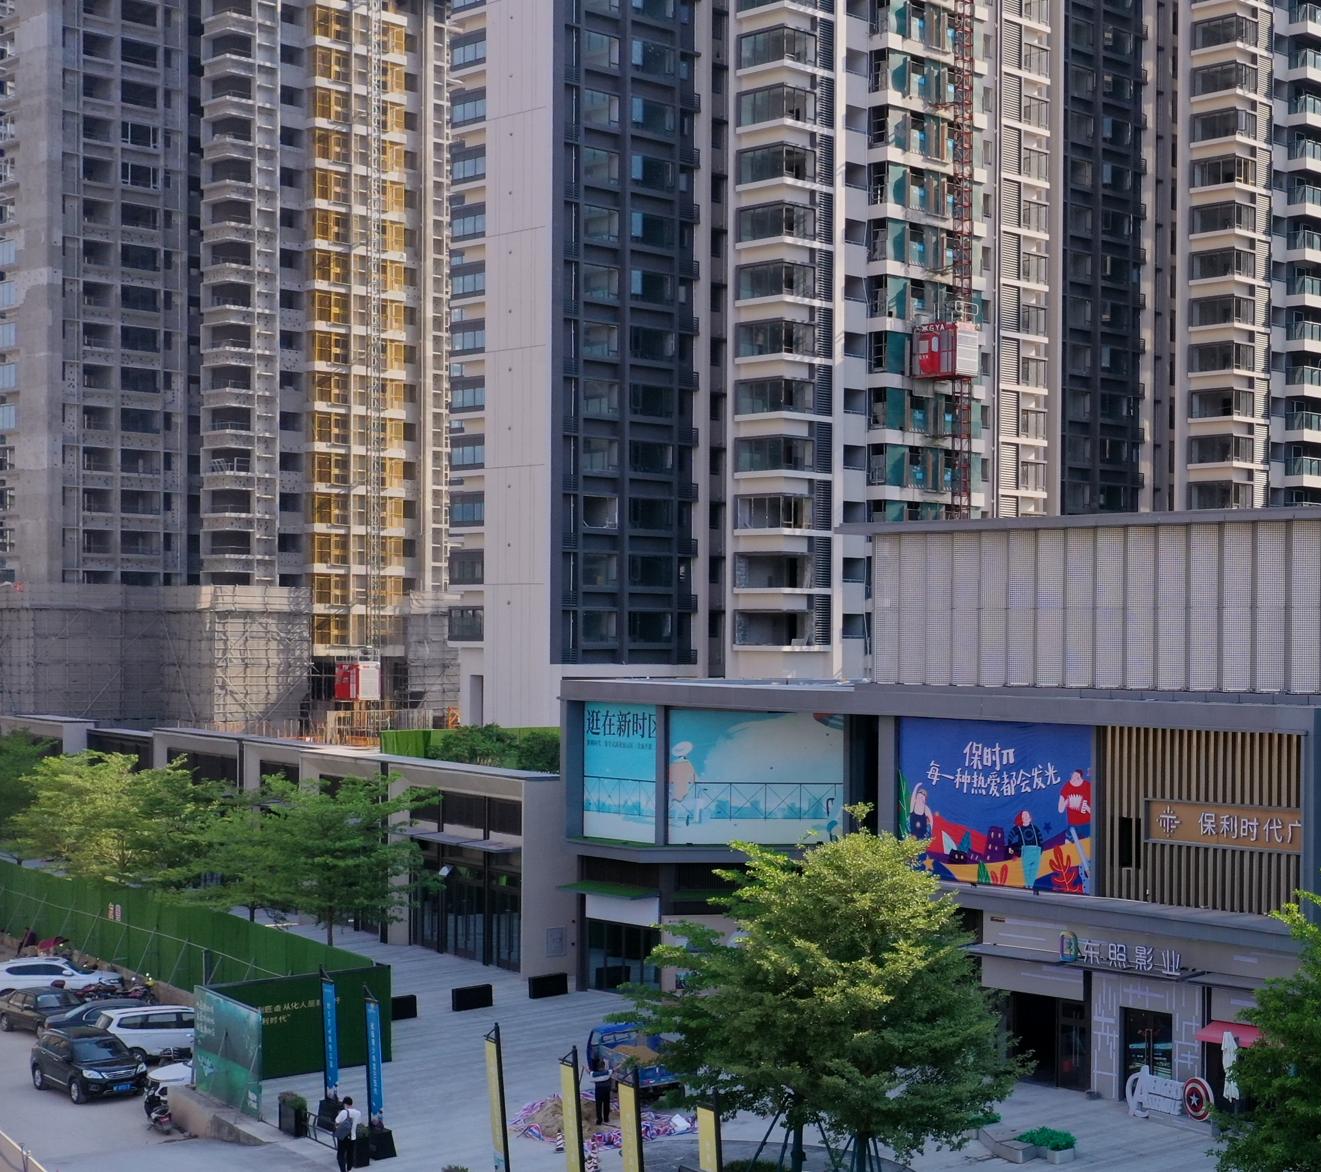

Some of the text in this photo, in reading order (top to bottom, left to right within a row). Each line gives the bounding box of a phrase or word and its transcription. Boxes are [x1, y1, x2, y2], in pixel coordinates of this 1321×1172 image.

[925, 760, 1061, 798] 每一种热爱都会发光
[1198, 811, 1302, 844] 保利时代广
[1083, 940, 1180, 976] 东照影业
